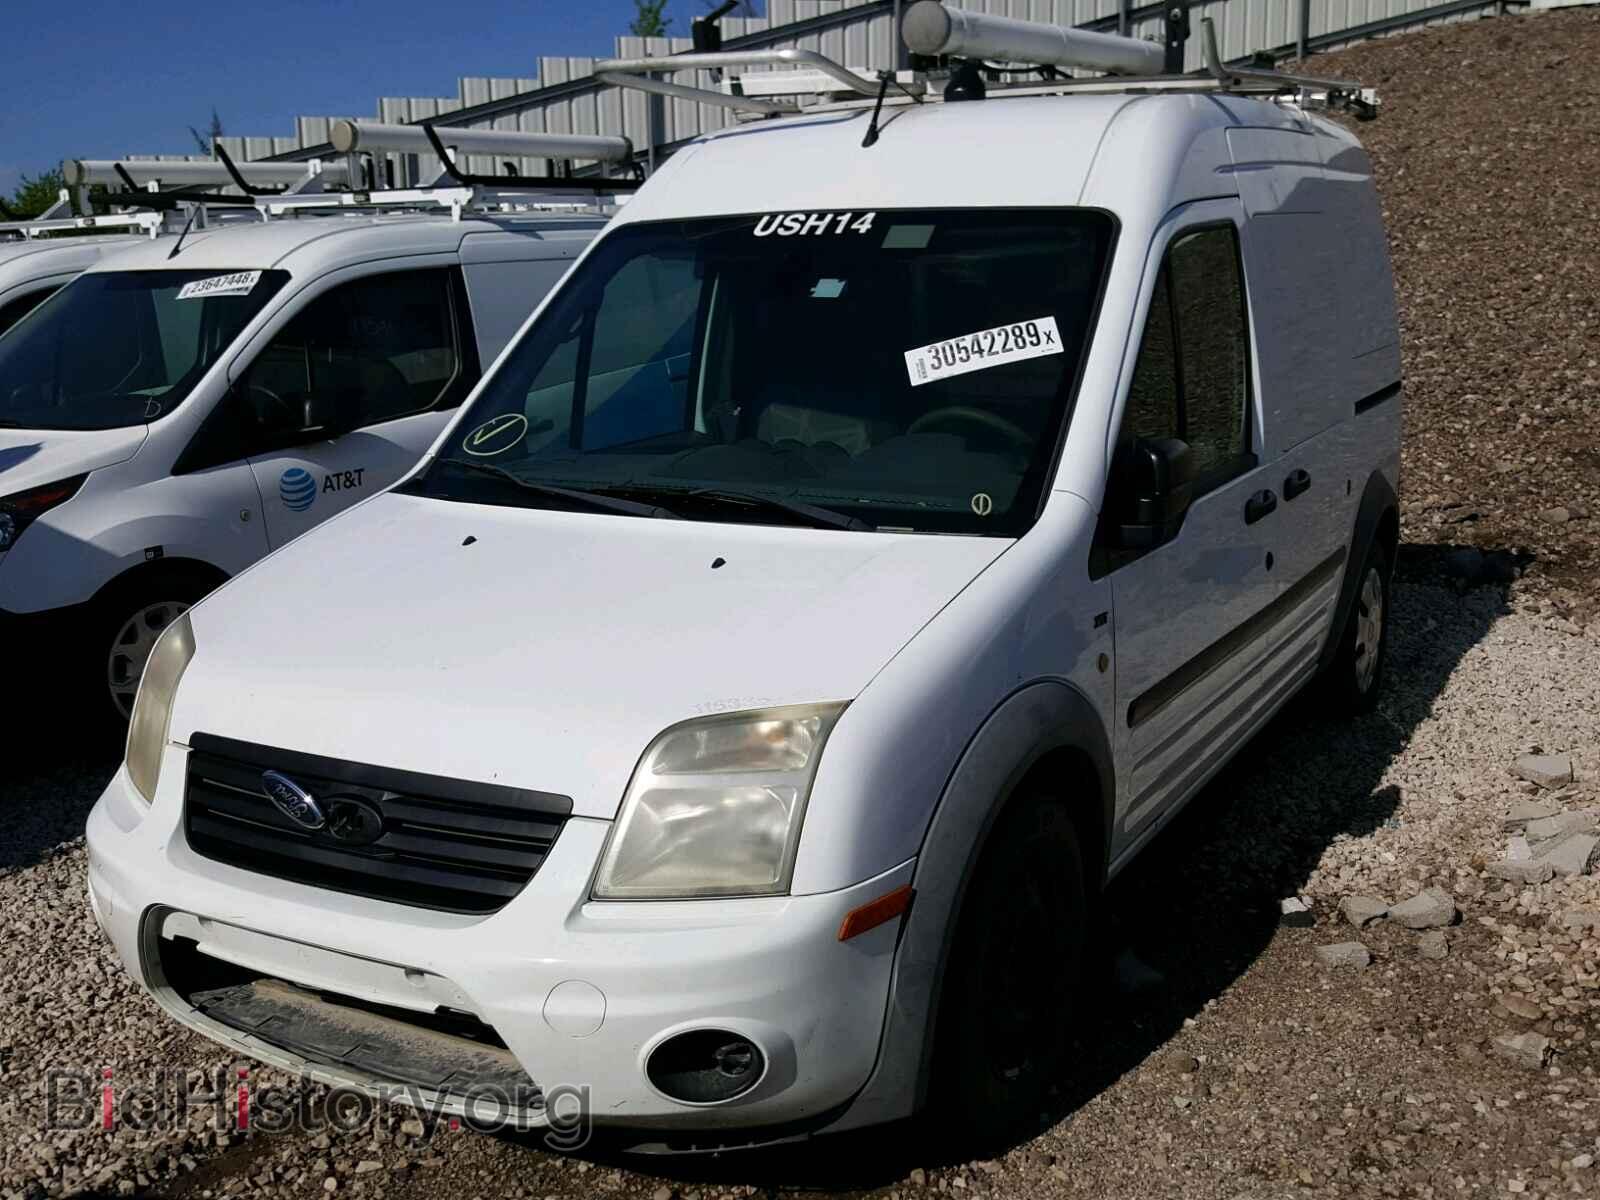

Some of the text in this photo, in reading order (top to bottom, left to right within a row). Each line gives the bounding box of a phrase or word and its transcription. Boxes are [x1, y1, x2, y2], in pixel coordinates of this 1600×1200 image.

[753, 212, 876, 237] USH14
[928, 322, 1041, 370] 30542289
[322, 468, 365, 493] AT&T
